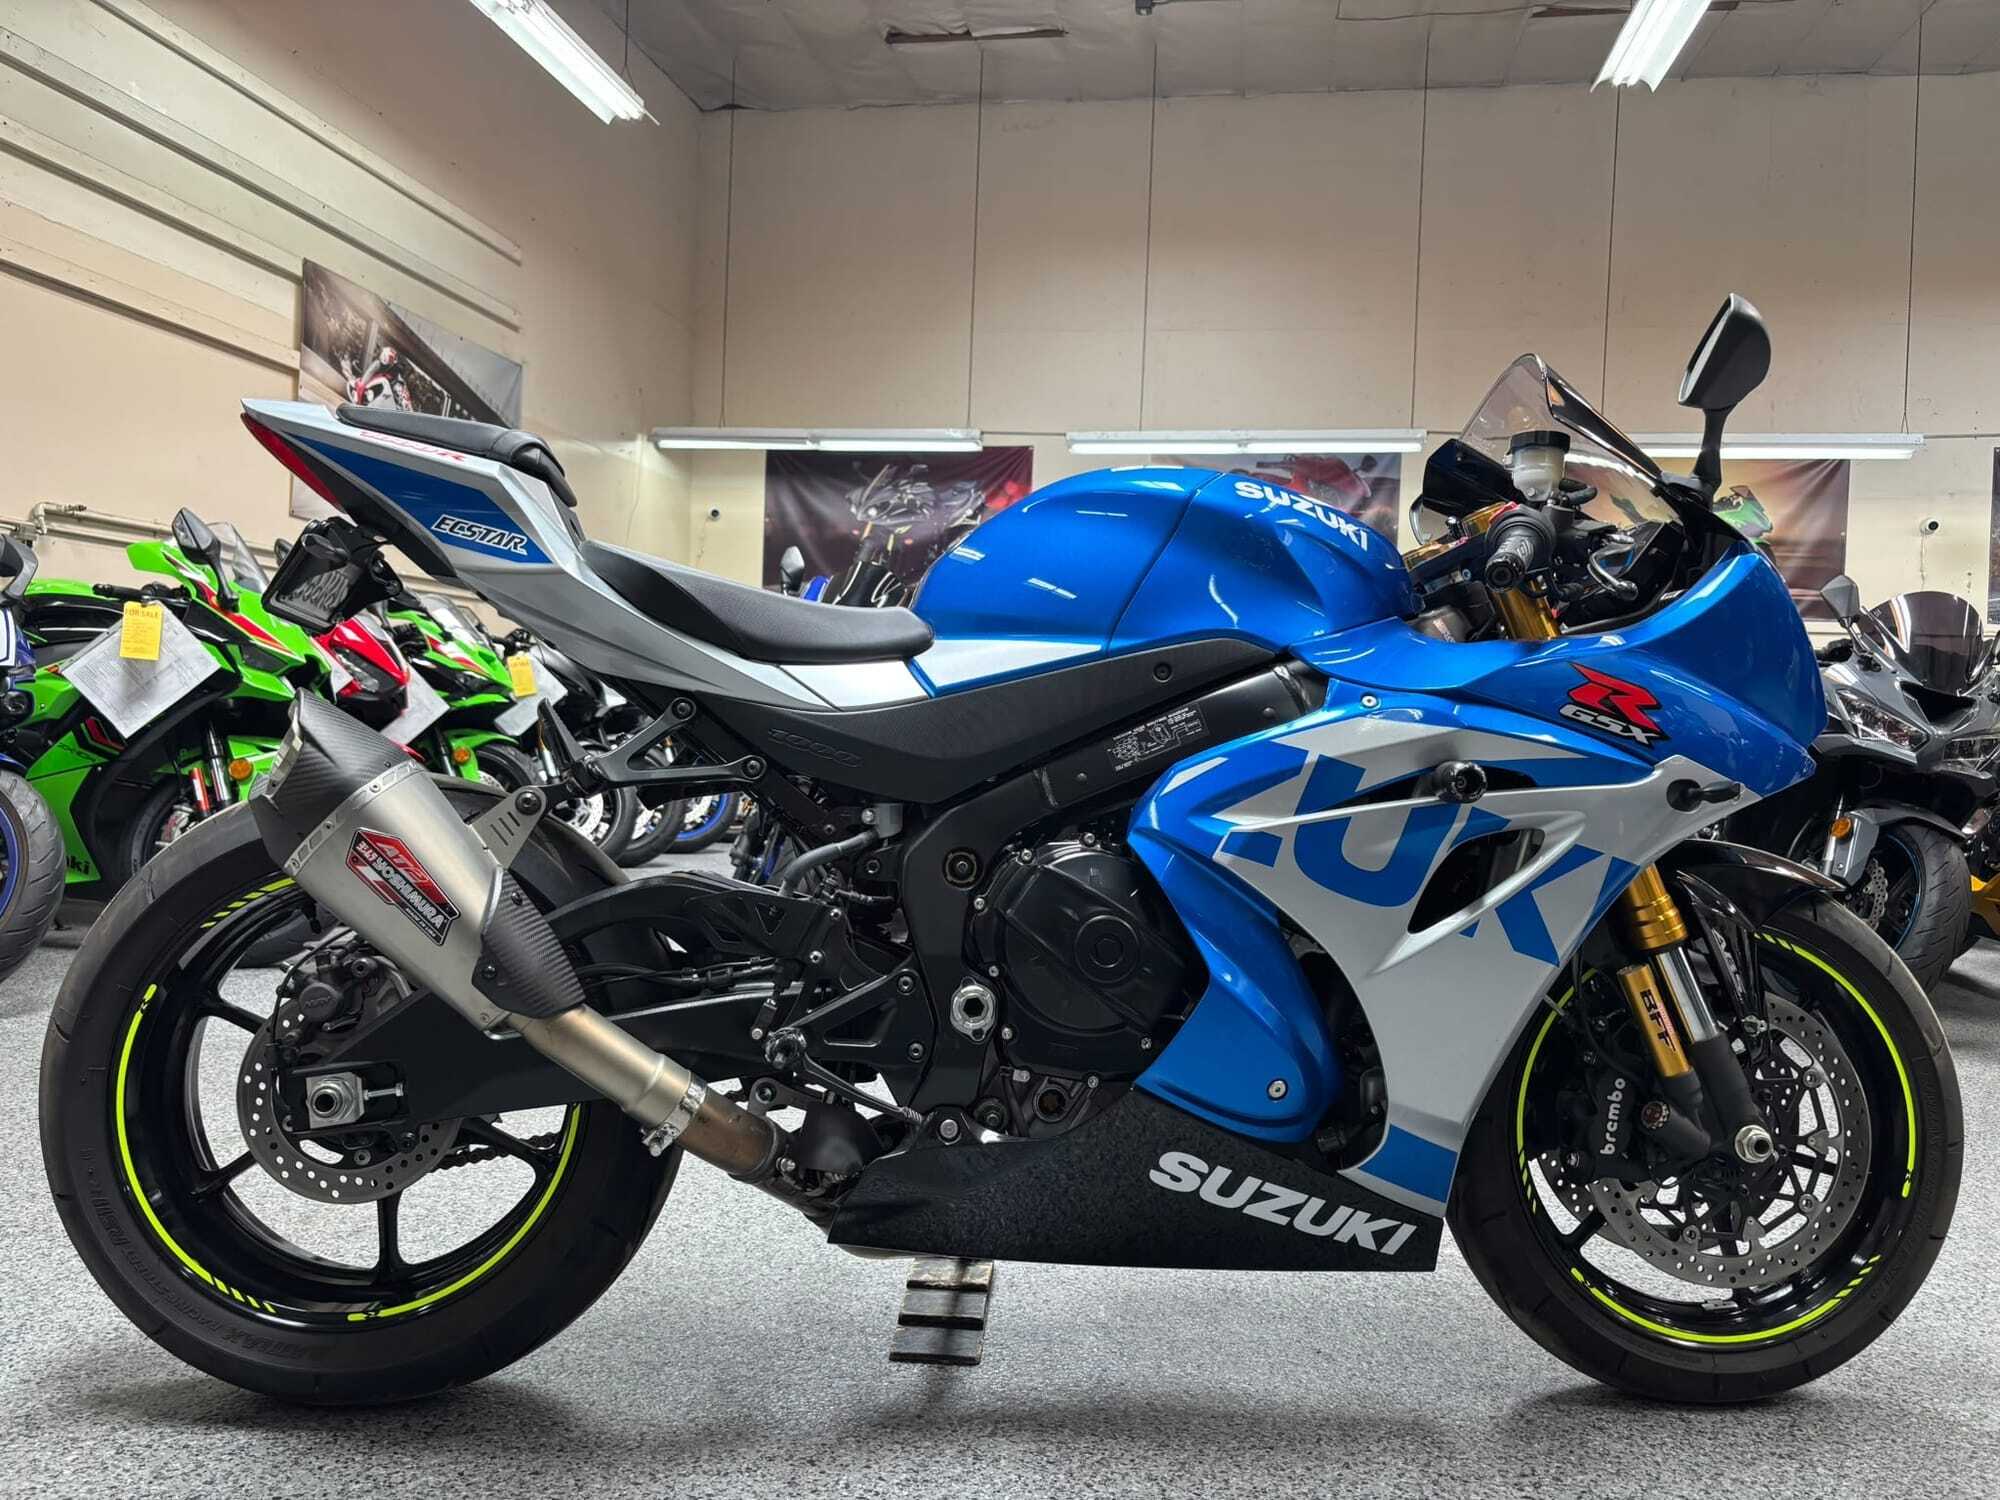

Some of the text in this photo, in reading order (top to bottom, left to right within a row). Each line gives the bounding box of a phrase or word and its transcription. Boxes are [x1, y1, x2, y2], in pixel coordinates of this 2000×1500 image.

[431, 514, 528, 555] ECSTAR
[1234, 481, 1368, 552] SUZUKI
[1559, 702, 1660, 745] GSX
[1570, 660, 1662, 734] R
[371, 855, 446, 929] YOSHIMURA
[1640, 988, 1678, 1052] BFF
[1600, 1077, 1627, 1155] brembo
[1149, 1151, 1418, 1256] SUZUKI
